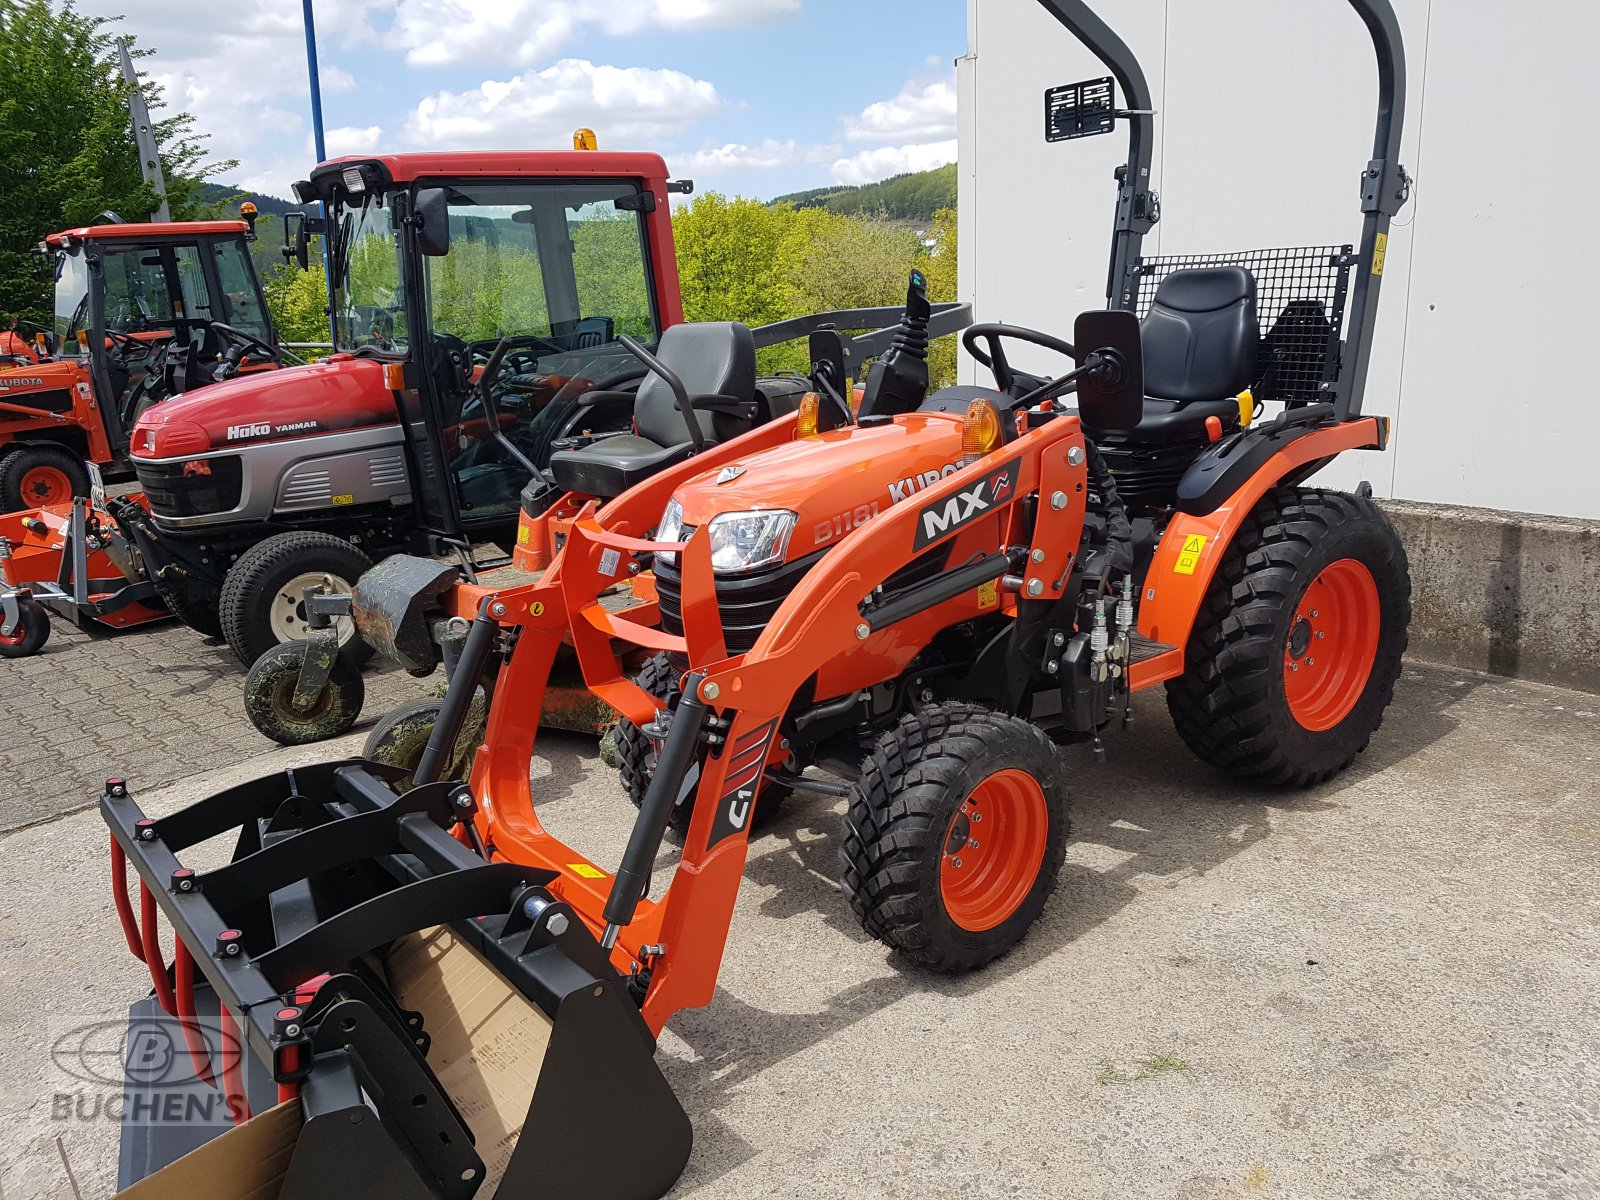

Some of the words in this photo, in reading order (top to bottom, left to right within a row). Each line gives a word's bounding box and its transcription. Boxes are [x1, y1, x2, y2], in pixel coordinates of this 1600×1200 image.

[227, 421, 270, 440] Hako
[275, 420, 317, 432] YANMAR
[814, 501, 879, 545] B1181
[922, 481, 990, 539] MX
[729, 790, 752, 829] C1
